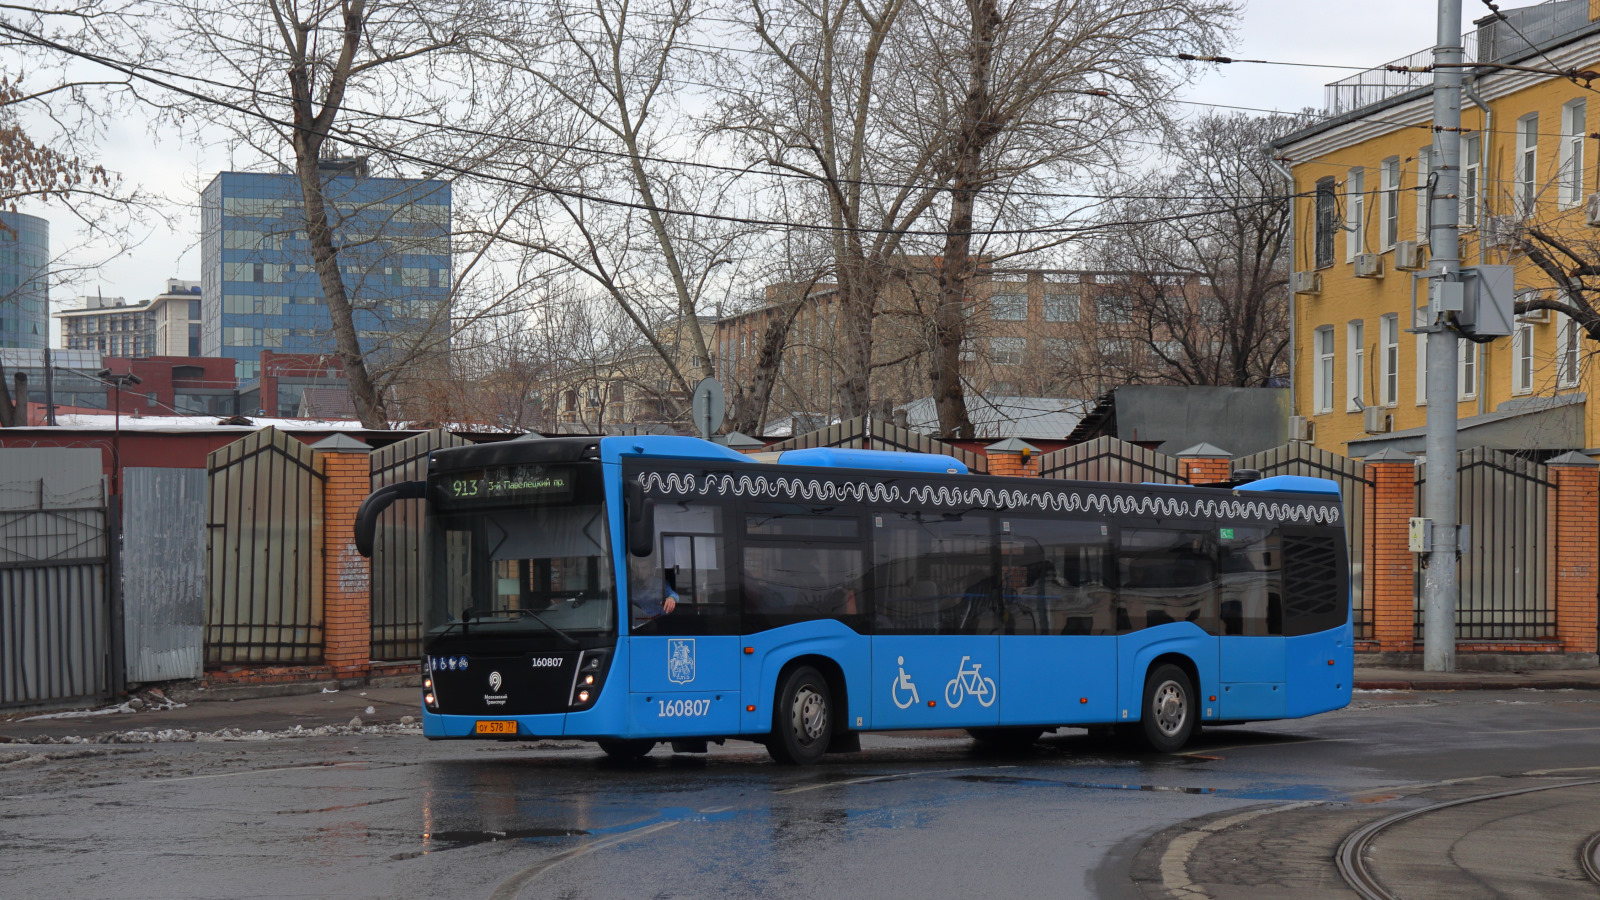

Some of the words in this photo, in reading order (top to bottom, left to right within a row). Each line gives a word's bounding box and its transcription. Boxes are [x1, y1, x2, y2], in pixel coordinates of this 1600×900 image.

[453, 479, 478, 496] 913
[504, 478, 551, 489] Павелецкий
[553, 479, 565, 488] пр.
[532, 657, 563, 667] 160807
[658, 699, 711, 717] 160807
[490, 722, 504, 732] 578
